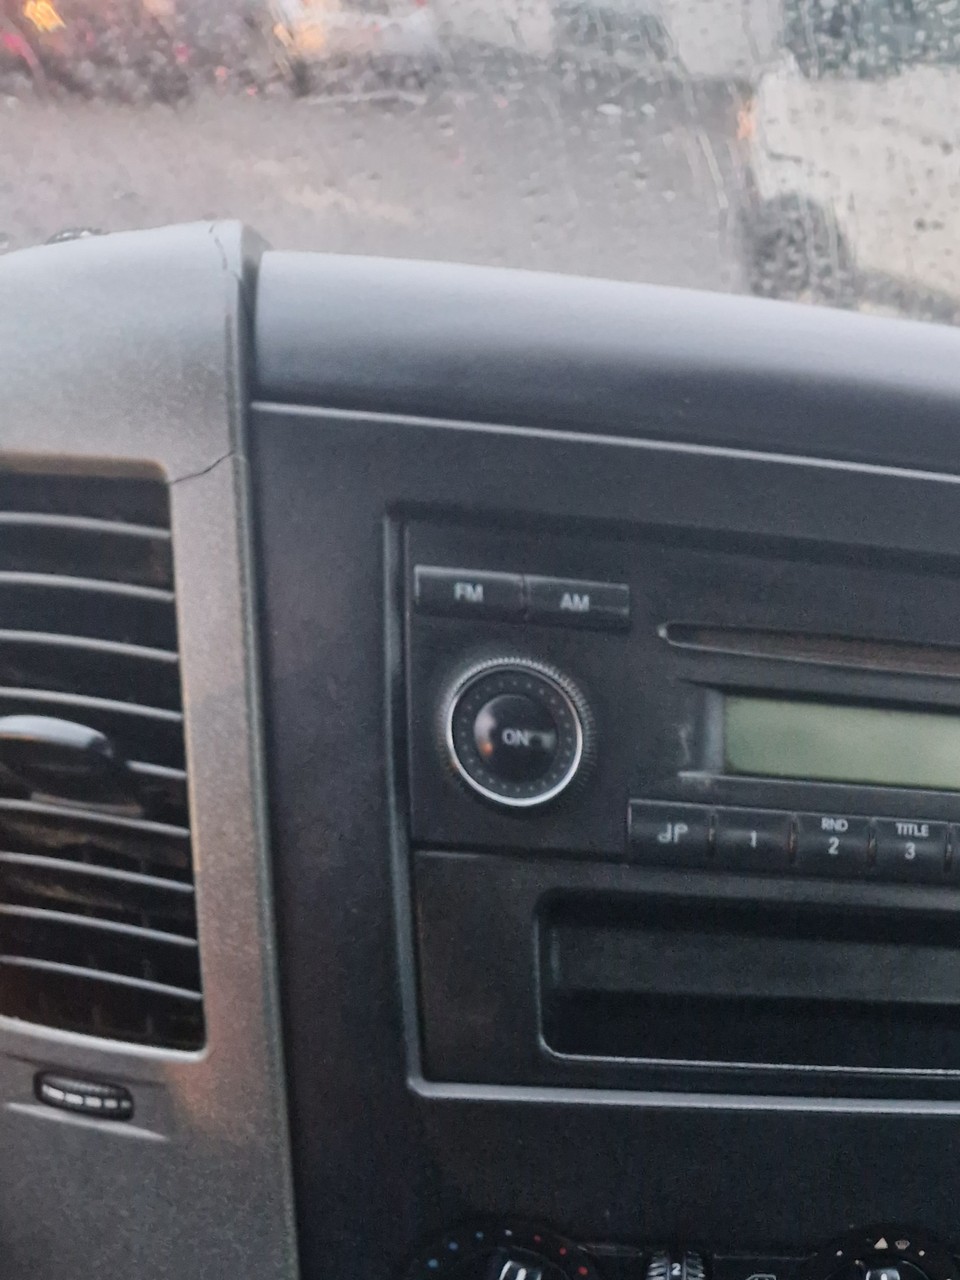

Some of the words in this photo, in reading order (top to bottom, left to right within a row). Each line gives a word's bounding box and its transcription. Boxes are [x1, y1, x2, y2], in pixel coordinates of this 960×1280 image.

[454, 583, 483, 601] FM
[560, 593, 590, 612] AM
[502, 729, 528, 746] ON
[821, 817, 848, 832] RND
[895, 822, 929, 838] TITLE
[750, 830, 757, 848] 1
[828, 837, 840, 855] 2
[904, 842, 916, 860] 3
[671, 1262, 681, 1276] 2
